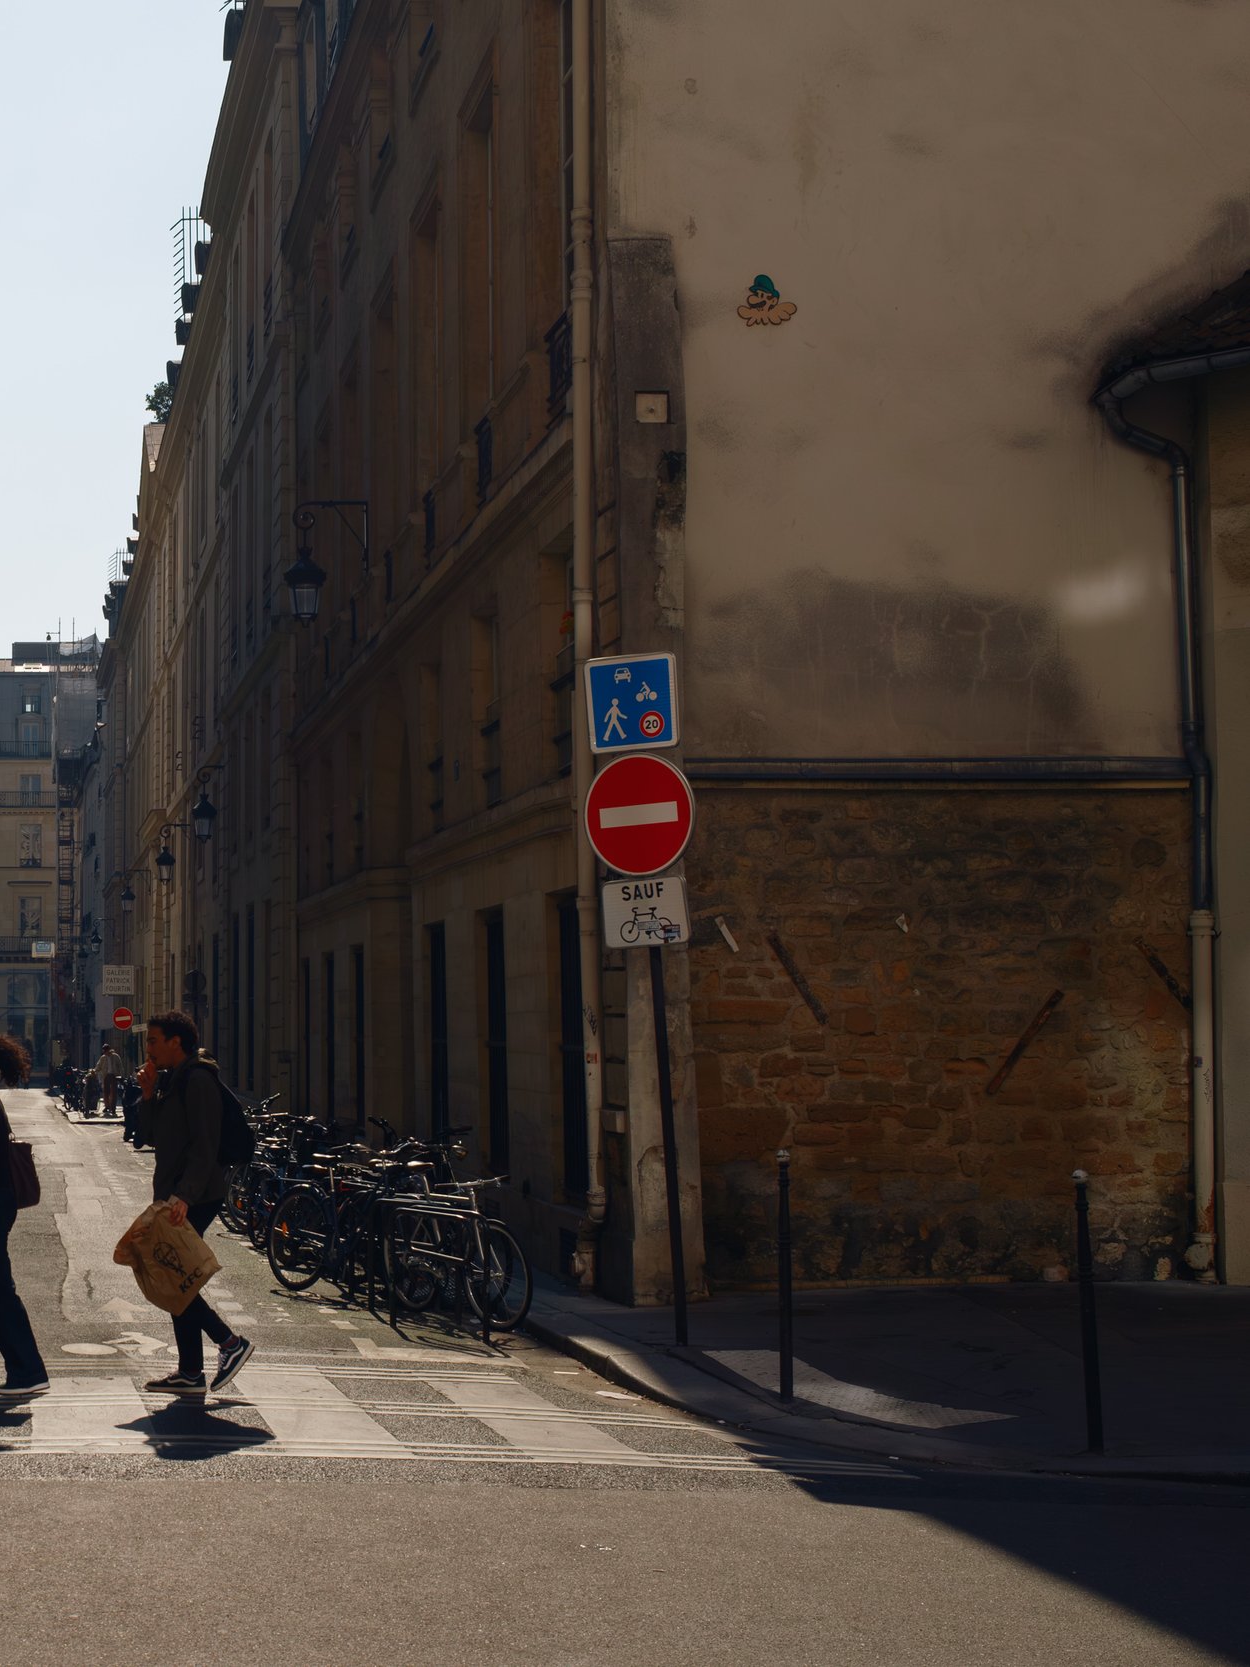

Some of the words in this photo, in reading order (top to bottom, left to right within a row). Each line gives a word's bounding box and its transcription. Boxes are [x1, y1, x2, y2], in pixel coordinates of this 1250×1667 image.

[645, 719, 659, 730] 20
[621, 881, 664, 901] SAUF
[179, 1267, 204, 1293] KFC
